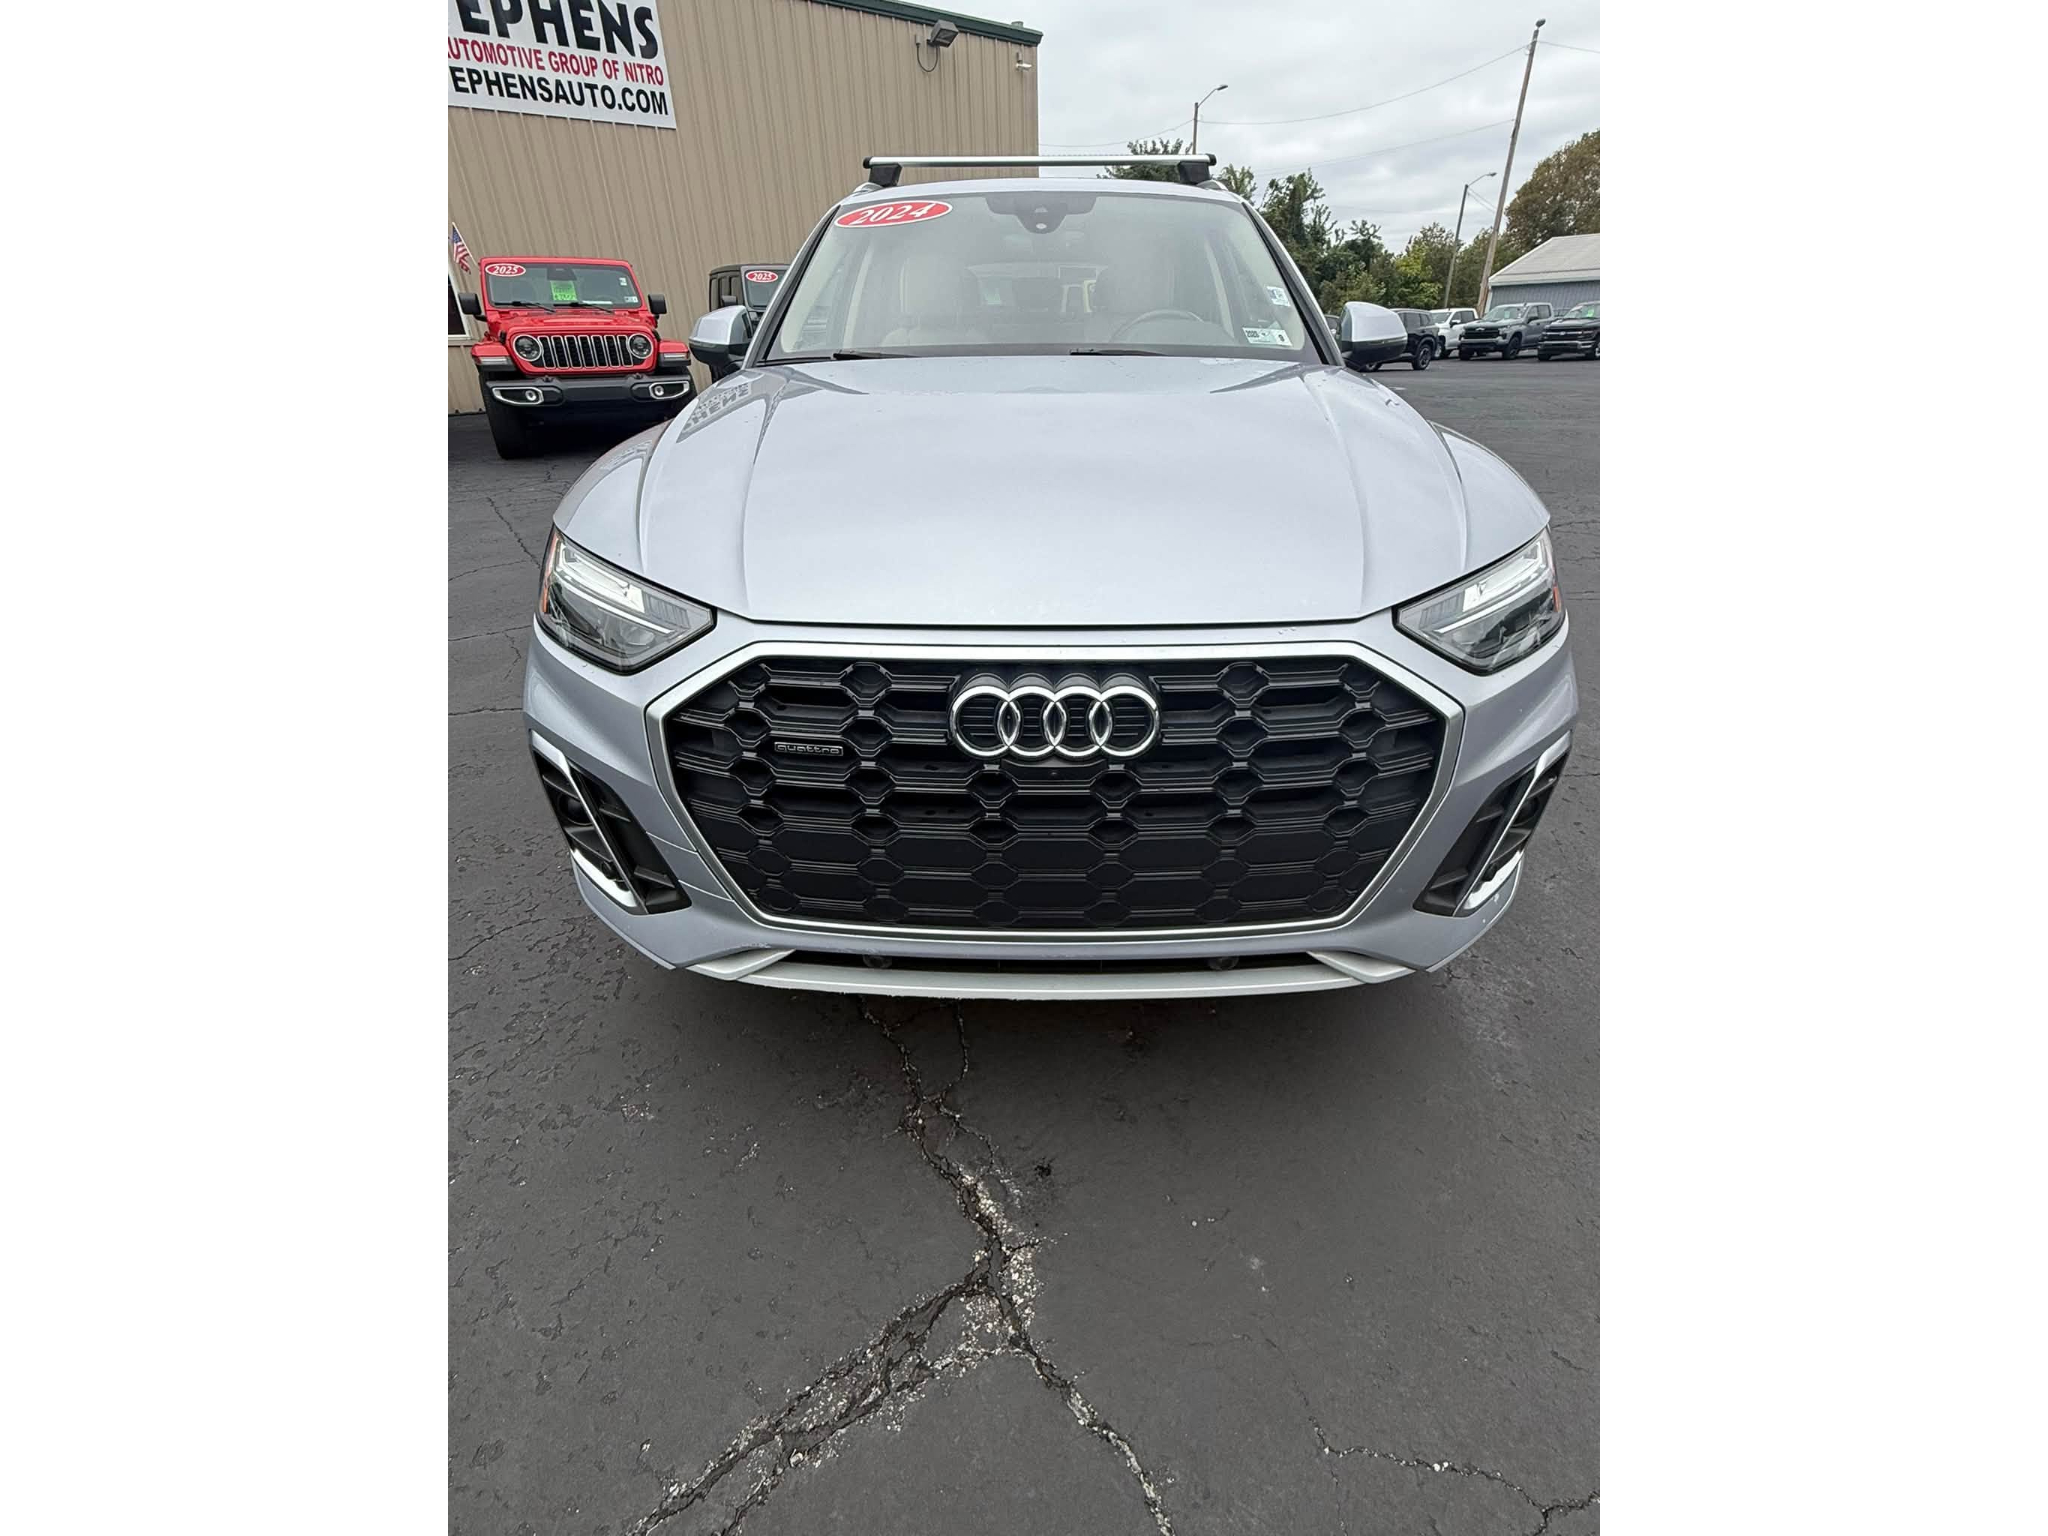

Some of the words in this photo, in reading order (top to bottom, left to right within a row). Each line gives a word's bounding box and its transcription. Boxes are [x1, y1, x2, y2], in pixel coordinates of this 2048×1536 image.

[448, 36, 545, 71] UTOMOTIVE
[548, 50, 598, 78] GROUP
[602, 58, 619, 80] OF
[623, 61, 664, 86] NITRO
[449, 66, 668, 115] EPHENSAUTO.COM
[848, 202, 937, 226] 2024
[493, 265, 519, 275] 2025
[753, 271, 773, 282] 2025
[777, 744, 840, 754] quattro
